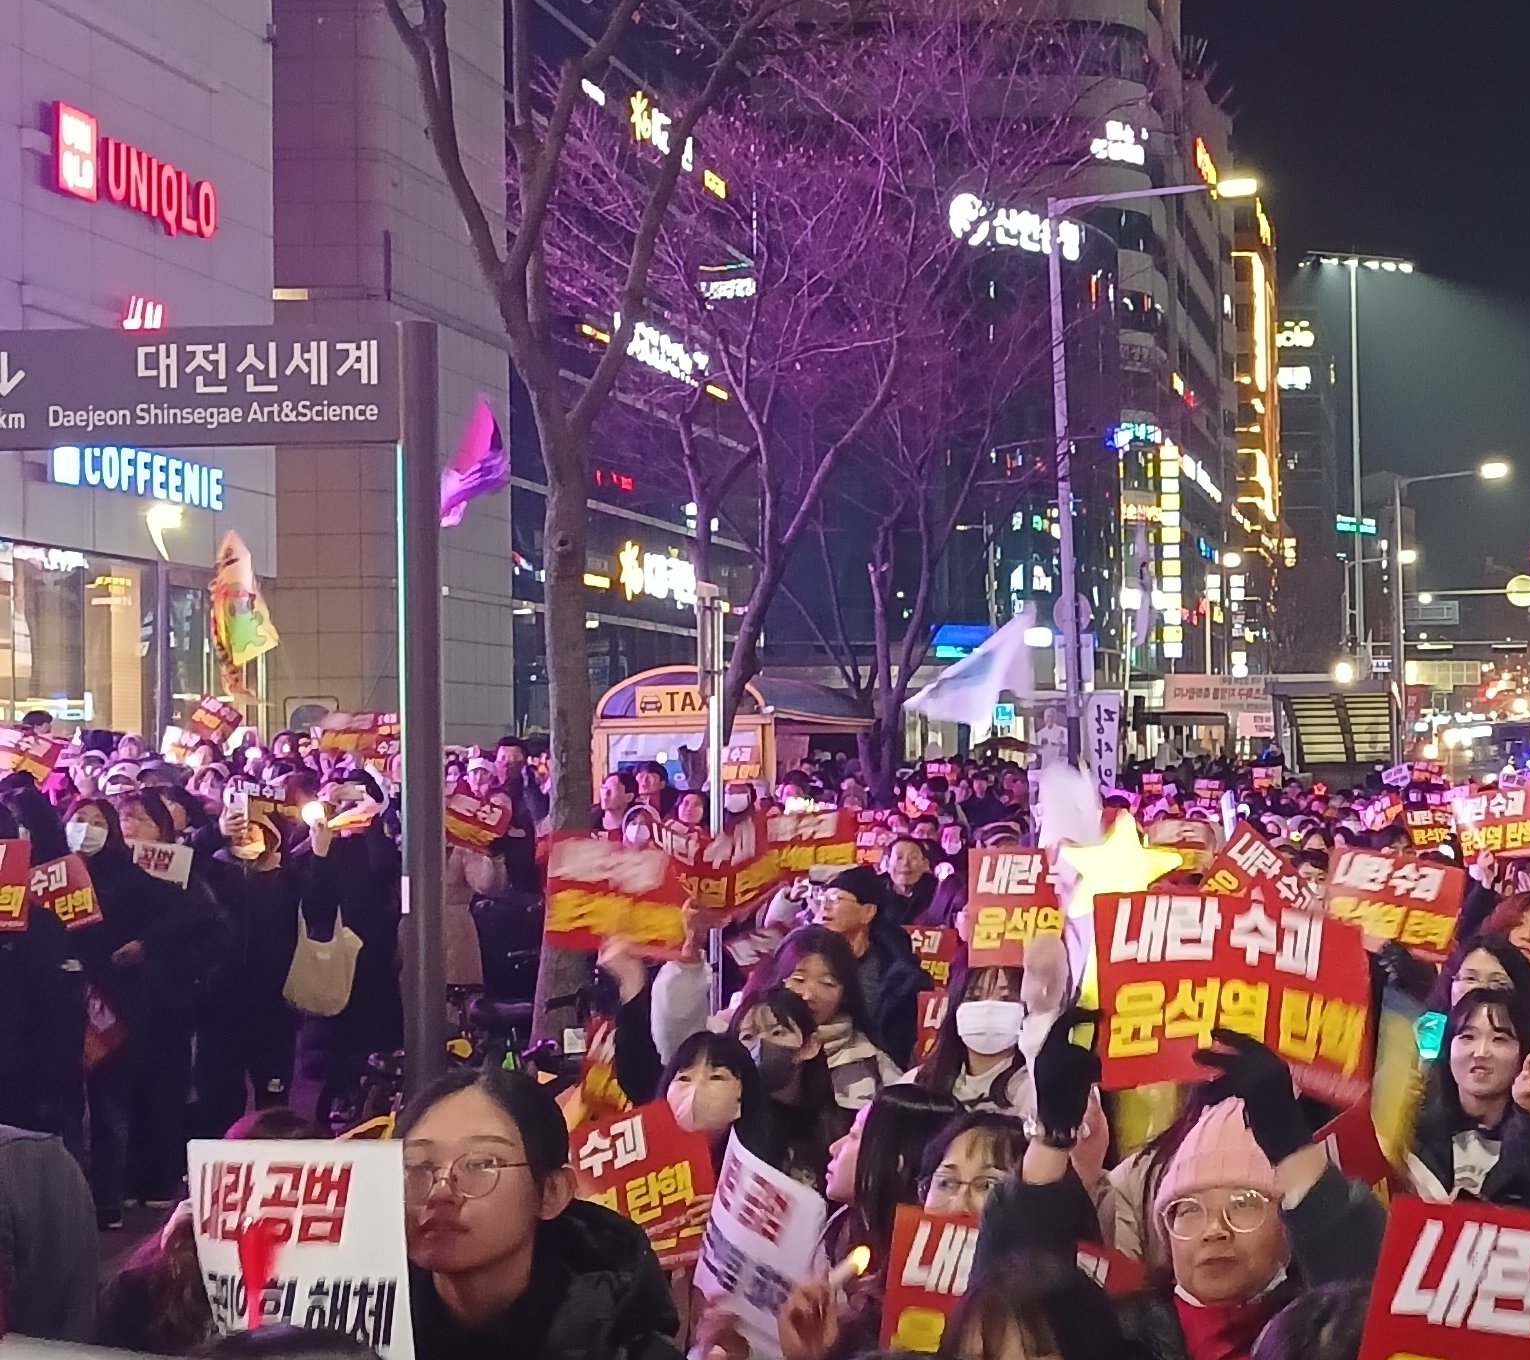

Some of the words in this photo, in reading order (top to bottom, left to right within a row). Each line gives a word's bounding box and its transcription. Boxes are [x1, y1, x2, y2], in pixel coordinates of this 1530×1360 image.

[106, 138, 217, 239] UNIQLO
[137, 340, 379, 393] 대전신세계
[48, 404, 131, 431] Daejeon
[135, 403, 243, 431] Shinsegae
[247, 400, 378, 425] Art&Science
[84, 446, 224, 511] COFFEENIE
[1488, 790, 1526, 819] 수괴
[31, 861, 69, 897] 수괴
[976, 854, 1042, 895] 내란
[1334, 850, 1396, 892] 내란
[1393, 862, 1446, 902] 수괴
[1110, 894, 1221, 964] 내란
[1229, 900, 1326, 982] 수괴
[1107, 978, 1269, 1060] 윤석열
[1278, 991, 1368, 1076] 탄핵
[579, 1114, 647, 1179] 수괴
[262, 1160, 354, 1247] 공범
[625, 1160, 696, 1225] 탄핵
[901, 1220, 980, 1297] 내
[306, 1275, 397, 1346] 해체
